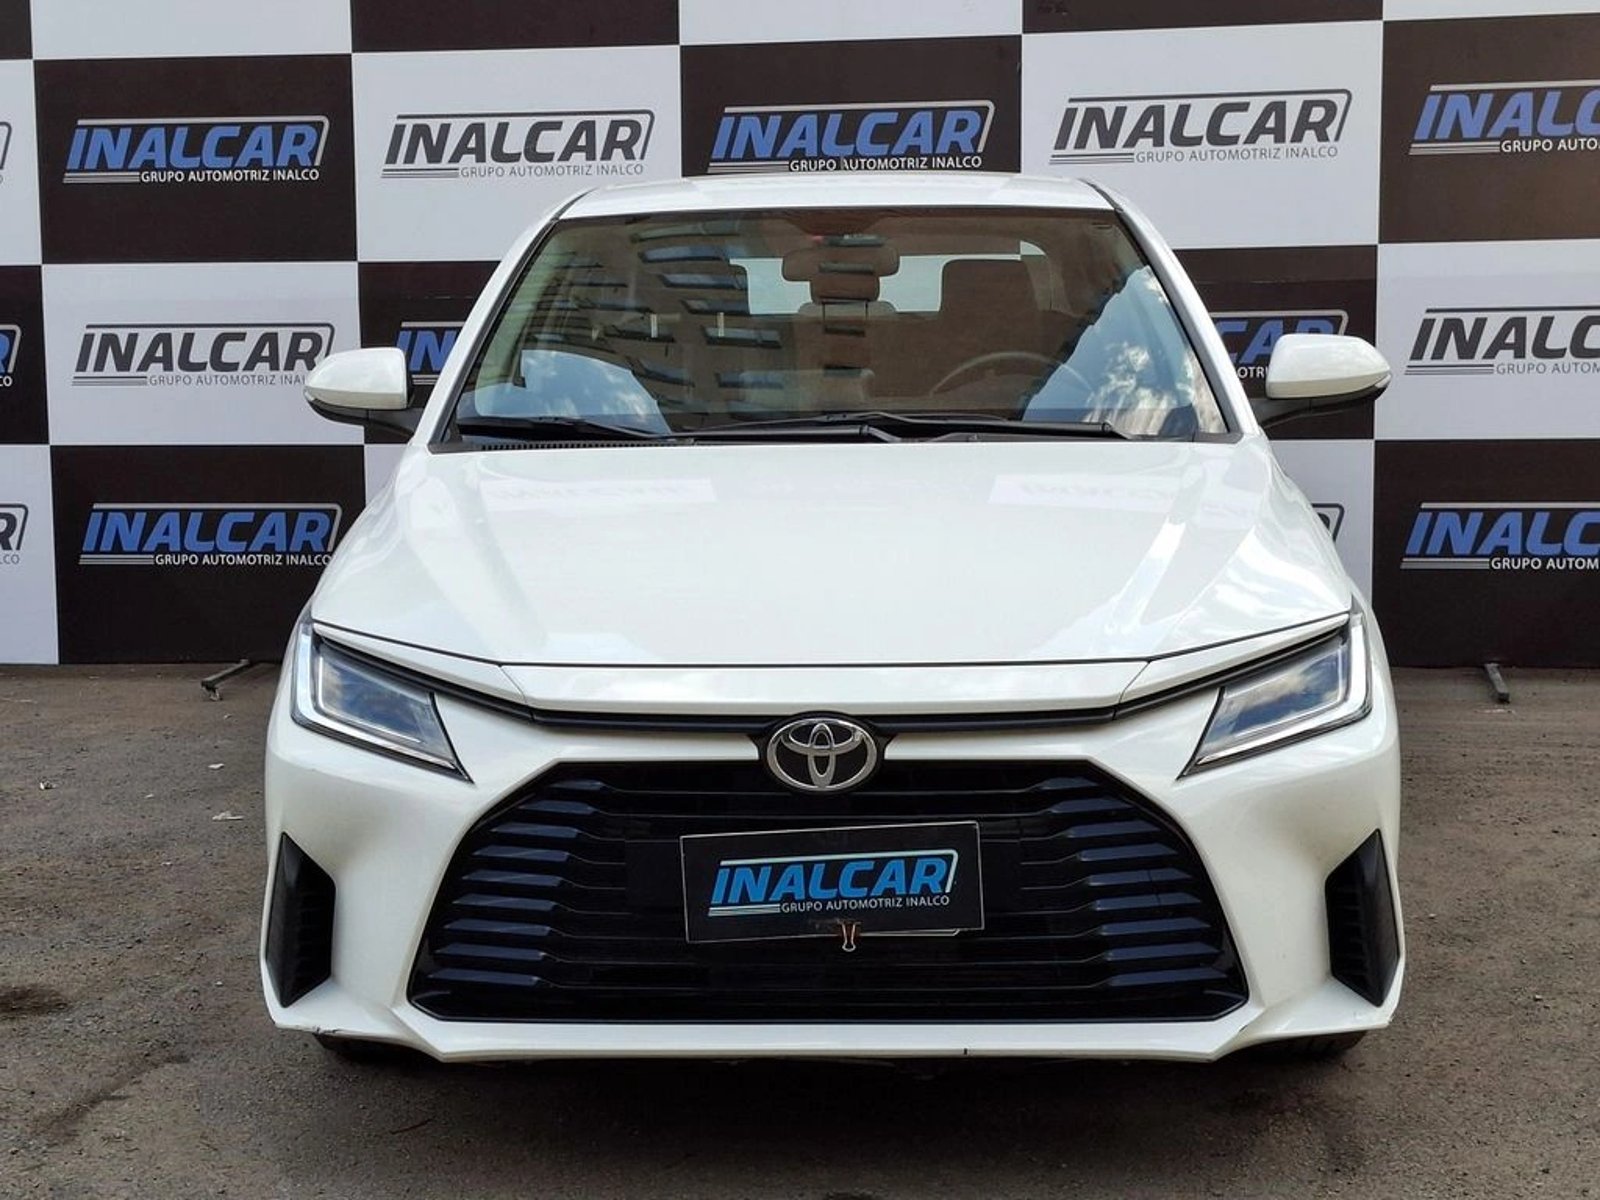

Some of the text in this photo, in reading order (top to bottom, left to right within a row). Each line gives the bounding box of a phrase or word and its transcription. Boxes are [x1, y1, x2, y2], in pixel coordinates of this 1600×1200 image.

[1053, 99, 1338, 150] INALCAR
[384, 119, 643, 165] INALCAR
[710, 110, 983, 160] INALCAR
[66, 124, 319, 170] INALCAR
[1501, 137, 1600, 153] GRUPO AUTO
[789, 155, 982, 171] GRUPO AUTOMOTRIZ INALCO
[1135, 146, 1339, 163] GRUPO AUTOMOTRIZ INALCO
[140, 168, 320, 183] GRUPO AUTOMOTRIZ INALCO
[460, 164, 644, 178] GRUPO AUTOMOTRIZ INALCO
[75, 332, 323, 373] INALCAR
[1496, 362, 1547, 374] GRUPO
[149, 375, 192, 386] GRUPO
[196, 375, 276, 385] AUTOMOTRIZ
[82, 511, 331, 552] INALCAR
[155, 554, 332, 566] GRUPO AUTOMOTRIZ INALCO
[1491, 557, 1542, 570] GRUPO
[710, 858, 948, 904] INALCAR
[781, 895, 950, 914] GRUPO AUTOMOTRIZ INALCO
